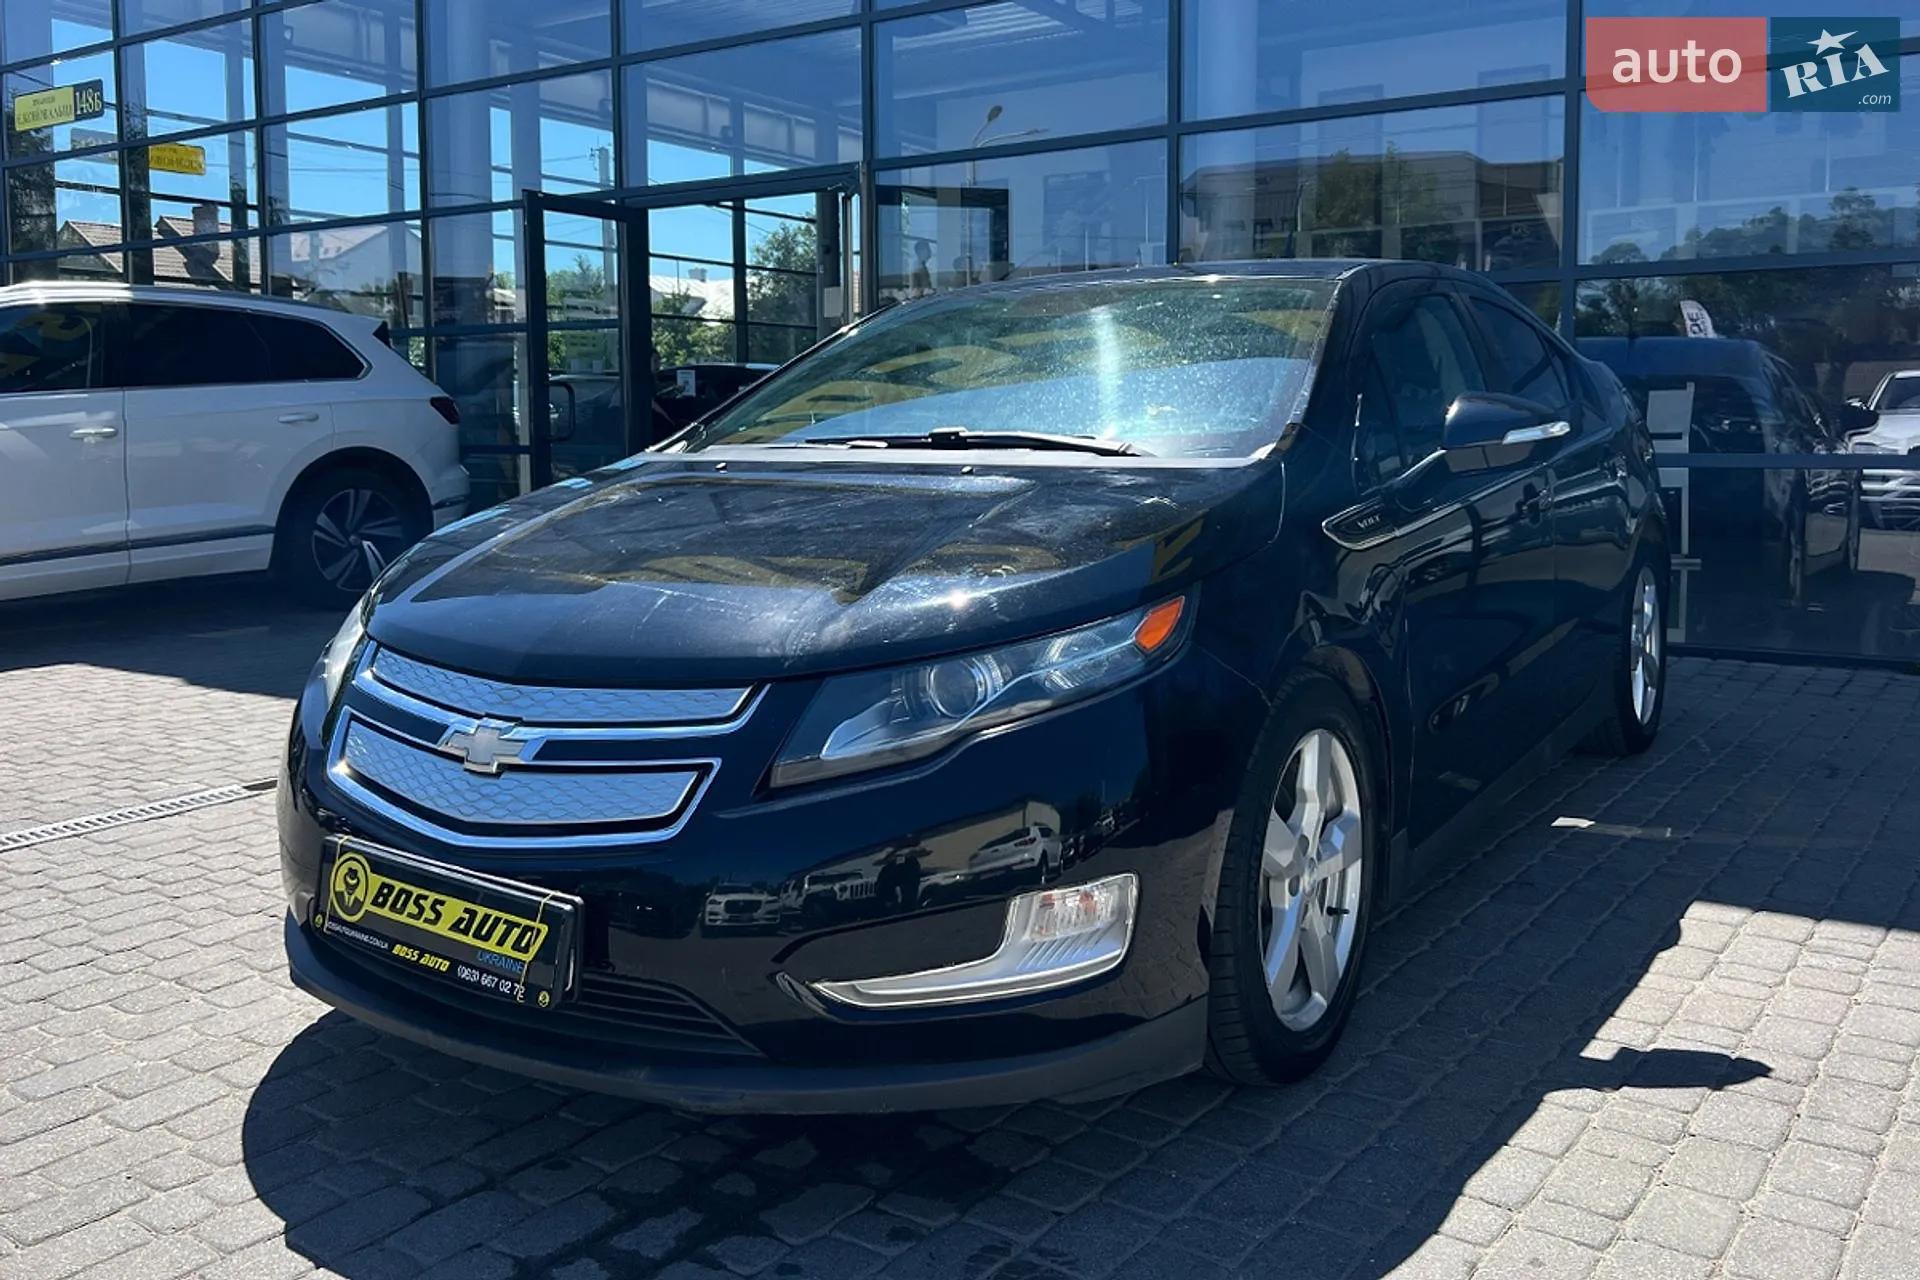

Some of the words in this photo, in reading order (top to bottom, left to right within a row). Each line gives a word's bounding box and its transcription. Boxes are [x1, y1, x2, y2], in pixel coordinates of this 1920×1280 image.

[369, 881, 446, 926] BOSS
[449, 907, 542, 954] AUTO
[391, 944, 419, 962] BOSS
[419, 953, 452, 972] AUTO
[476, 950, 525, 973] UKRAINE
[499, 979, 512, 993] 02
